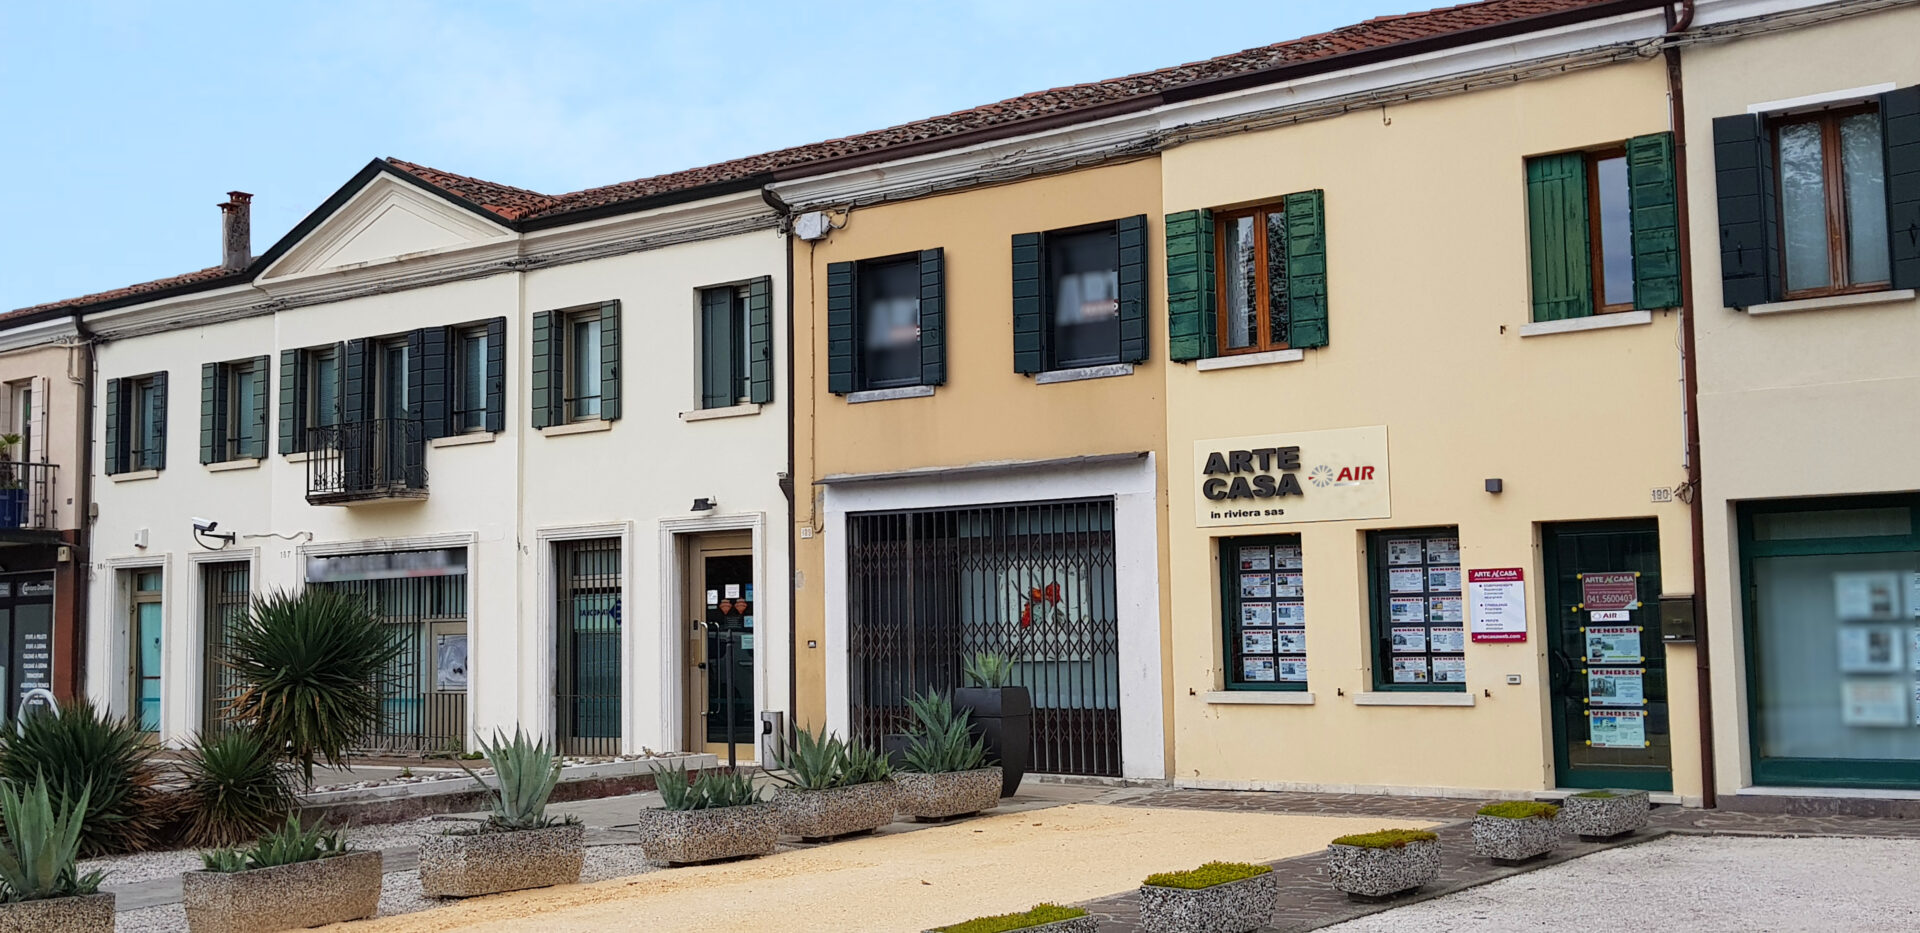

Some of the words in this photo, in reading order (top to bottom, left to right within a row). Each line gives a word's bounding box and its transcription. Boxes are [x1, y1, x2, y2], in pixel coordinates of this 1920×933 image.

[1203, 446, 1301, 474] ARTE
[1336, 466, 1375, 481] AIR
[1203, 473, 1304, 500] CASA
[1211, 511, 1220, 519] in
[1224, 509, 1261, 518] riviera
[1264, 508, 1284, 516] sas
[1586, 594, 1633, 603] 041.5600403
